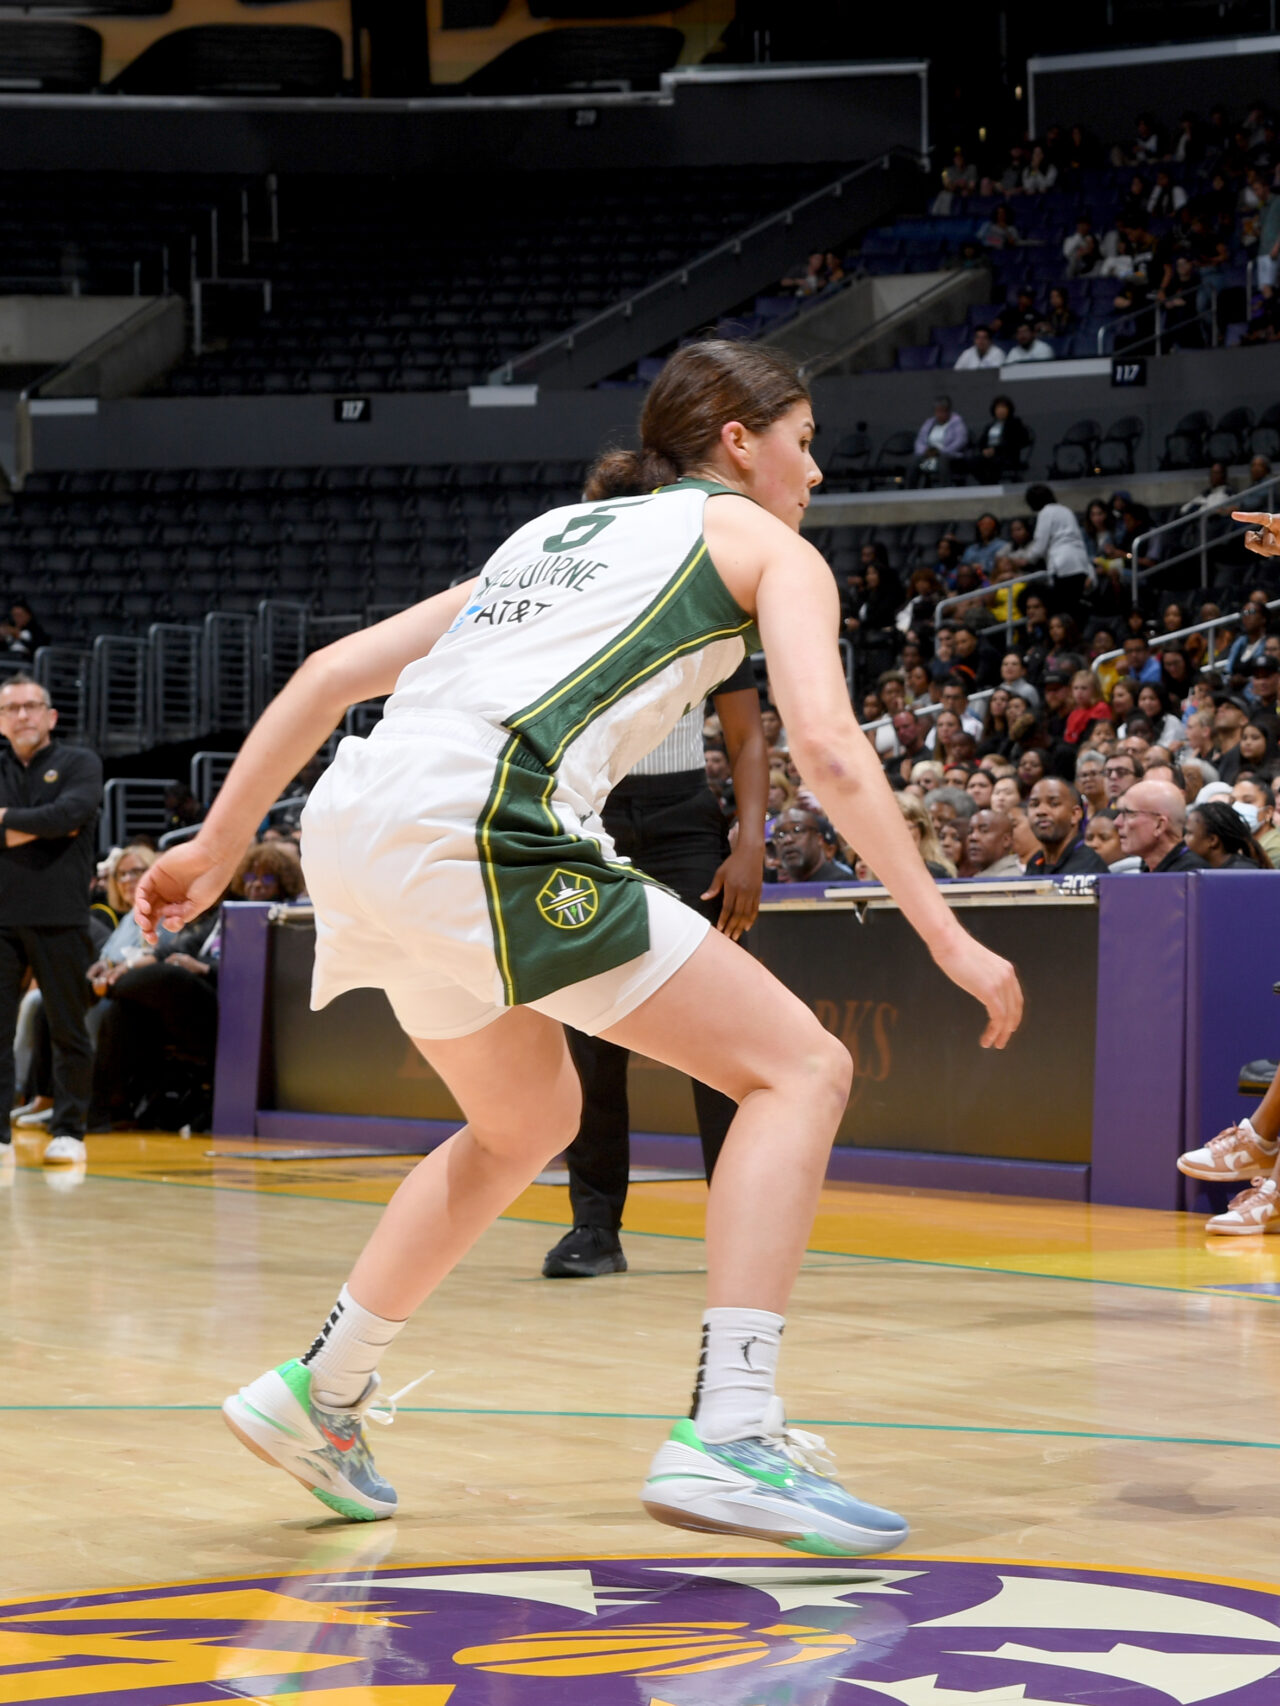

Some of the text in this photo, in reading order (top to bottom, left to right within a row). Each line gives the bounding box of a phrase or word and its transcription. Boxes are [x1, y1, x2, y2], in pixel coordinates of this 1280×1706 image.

[1116, 364, 1140, 382] 117
[342, 400, 365, 420] 117
[474, 599, 553, 625] AT&T
